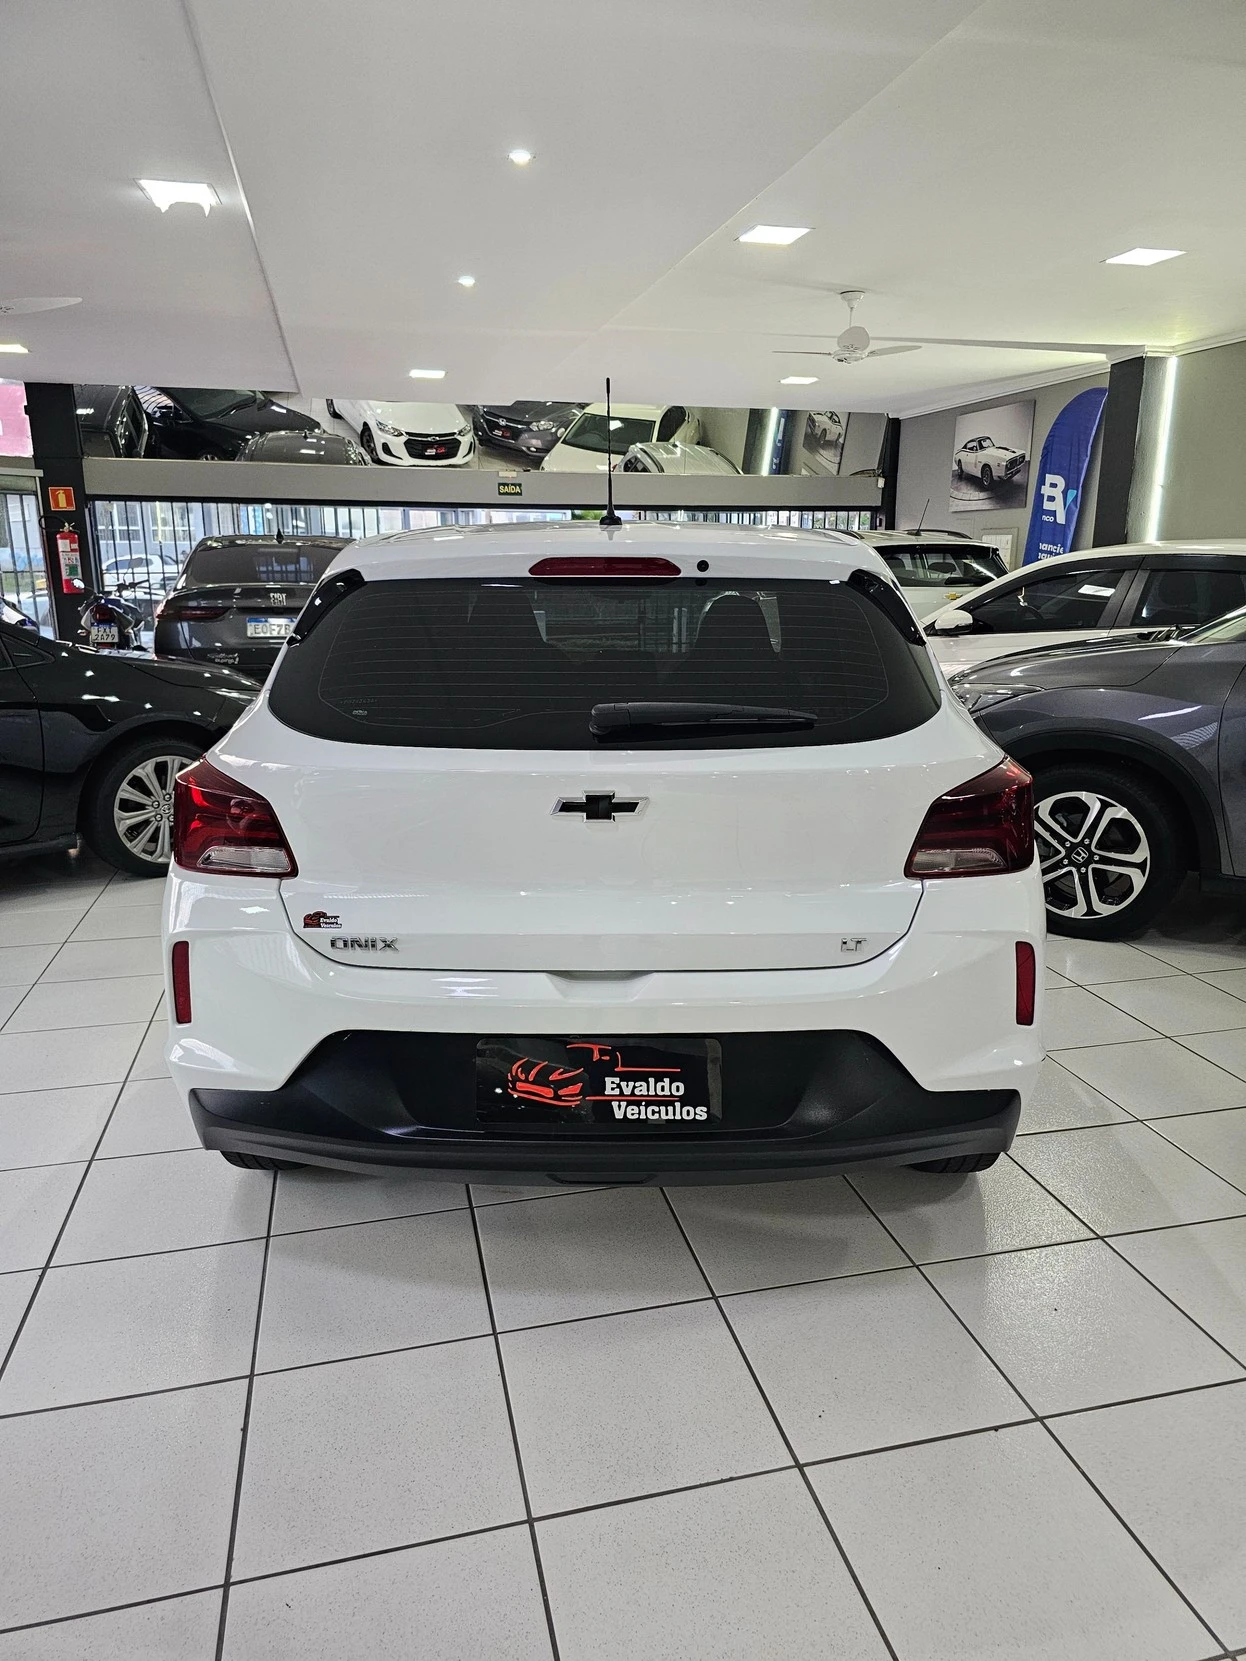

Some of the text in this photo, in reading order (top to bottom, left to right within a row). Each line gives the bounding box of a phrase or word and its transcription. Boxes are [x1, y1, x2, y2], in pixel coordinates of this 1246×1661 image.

[499, 484, 521, 493] SAÍDA
[269, 592, 287, 606] FIAT
[330, 936, 399, 952] ONIX
[841, 937, 867, 952] LT
[604, 1076, 685, 1096] Evaldo
[611, 1100, 708, 1120] Veículos
